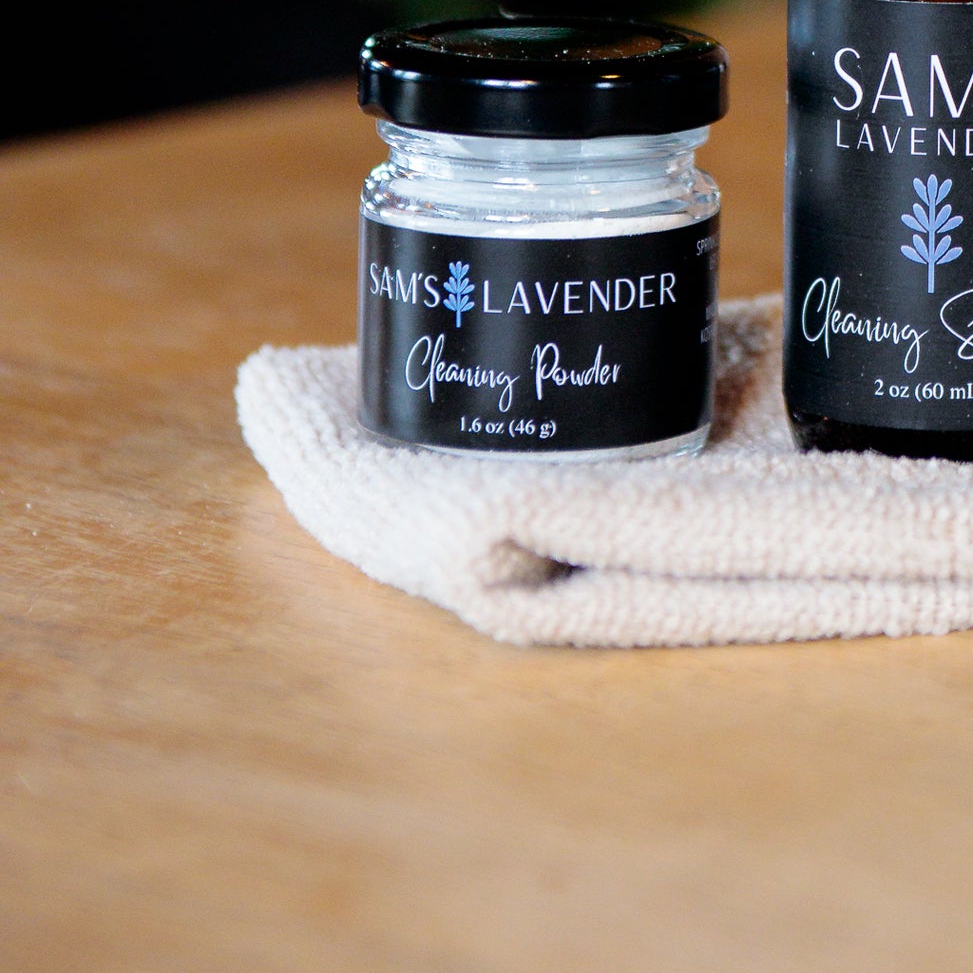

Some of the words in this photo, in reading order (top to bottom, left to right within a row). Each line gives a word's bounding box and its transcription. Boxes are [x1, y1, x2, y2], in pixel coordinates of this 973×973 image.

[368, 261, 442, 309] SAM'S
[482, 272, 676, 315] LAVENDER
[801, 275, 930, 374] Cleaning
[404, 332, 521, 414] Cleaning
[530, 342, 621, 401] Powder
[873, 378, 885, 396] 2
[888, 384, 910, 399] oz
[914, 381, 945, 403] (60
[460, 416, 482, 433] 1.6
[484, 421, 505, 434] oz
[508, 418, 536, 438] (46
[539, 420, 557, 439] g)
